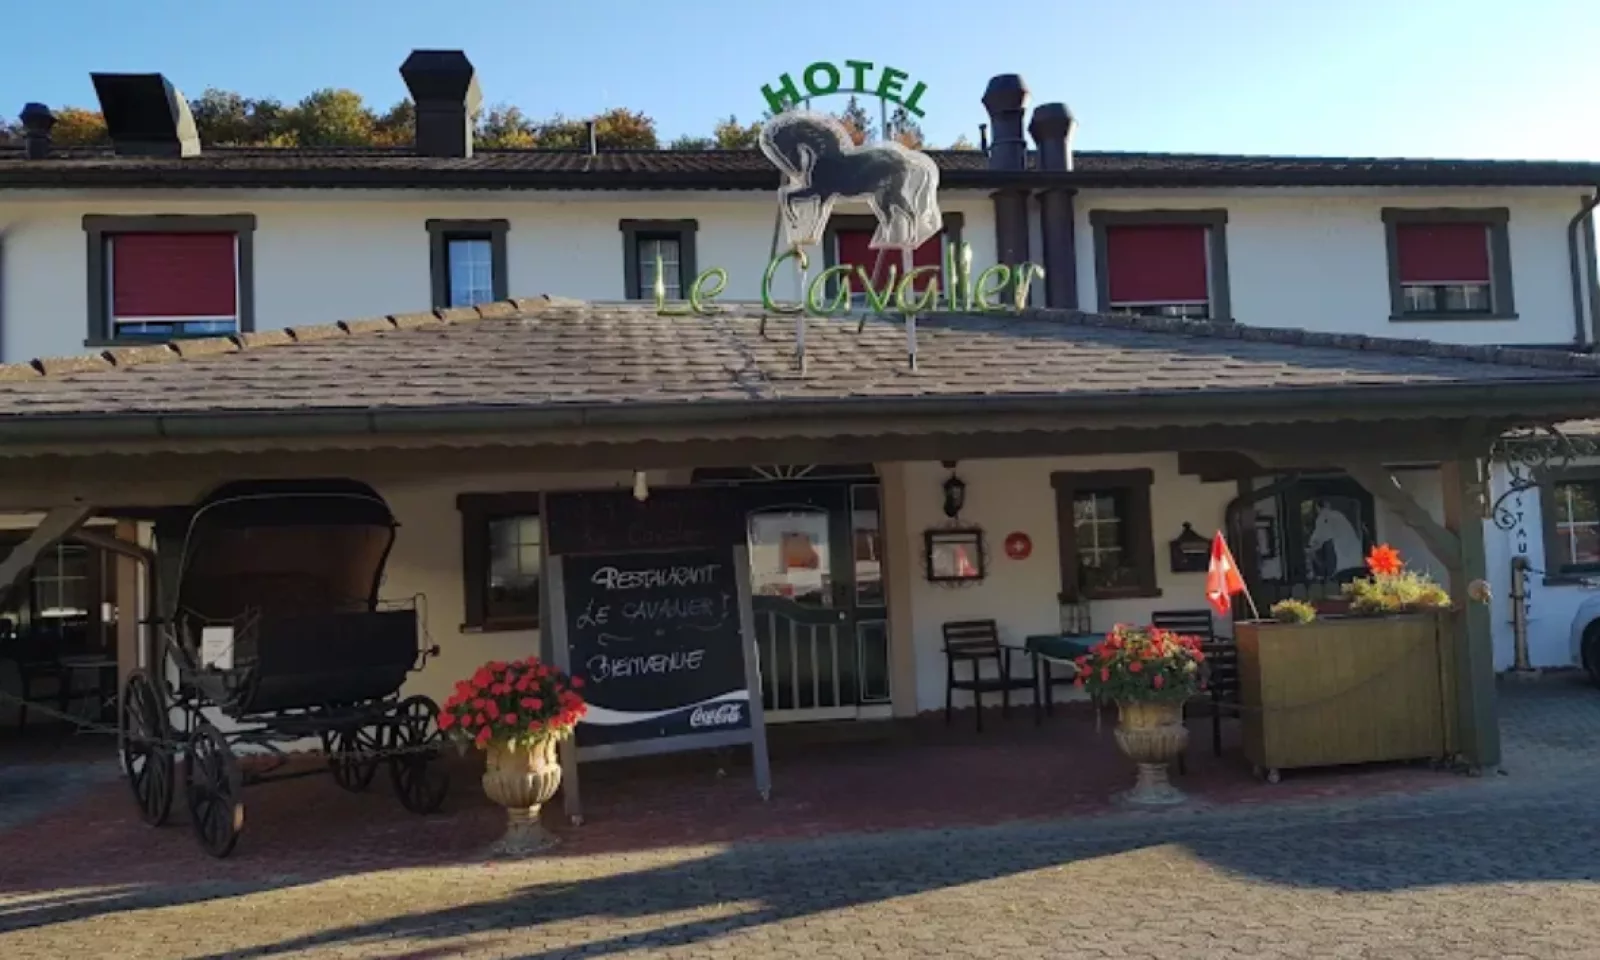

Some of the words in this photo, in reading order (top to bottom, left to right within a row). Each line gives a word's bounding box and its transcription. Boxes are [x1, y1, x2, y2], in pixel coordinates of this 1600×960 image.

[760, 59, 929, 119] HOTEL
[654, 254, 729, 316] Le
[762, 241, 1045, 317] Cavalier
[591, 564, 722, 590] RESTAURANT
[576, 597, 612, 629] LE
[586, 649, 706, 683] BIENVENUE
